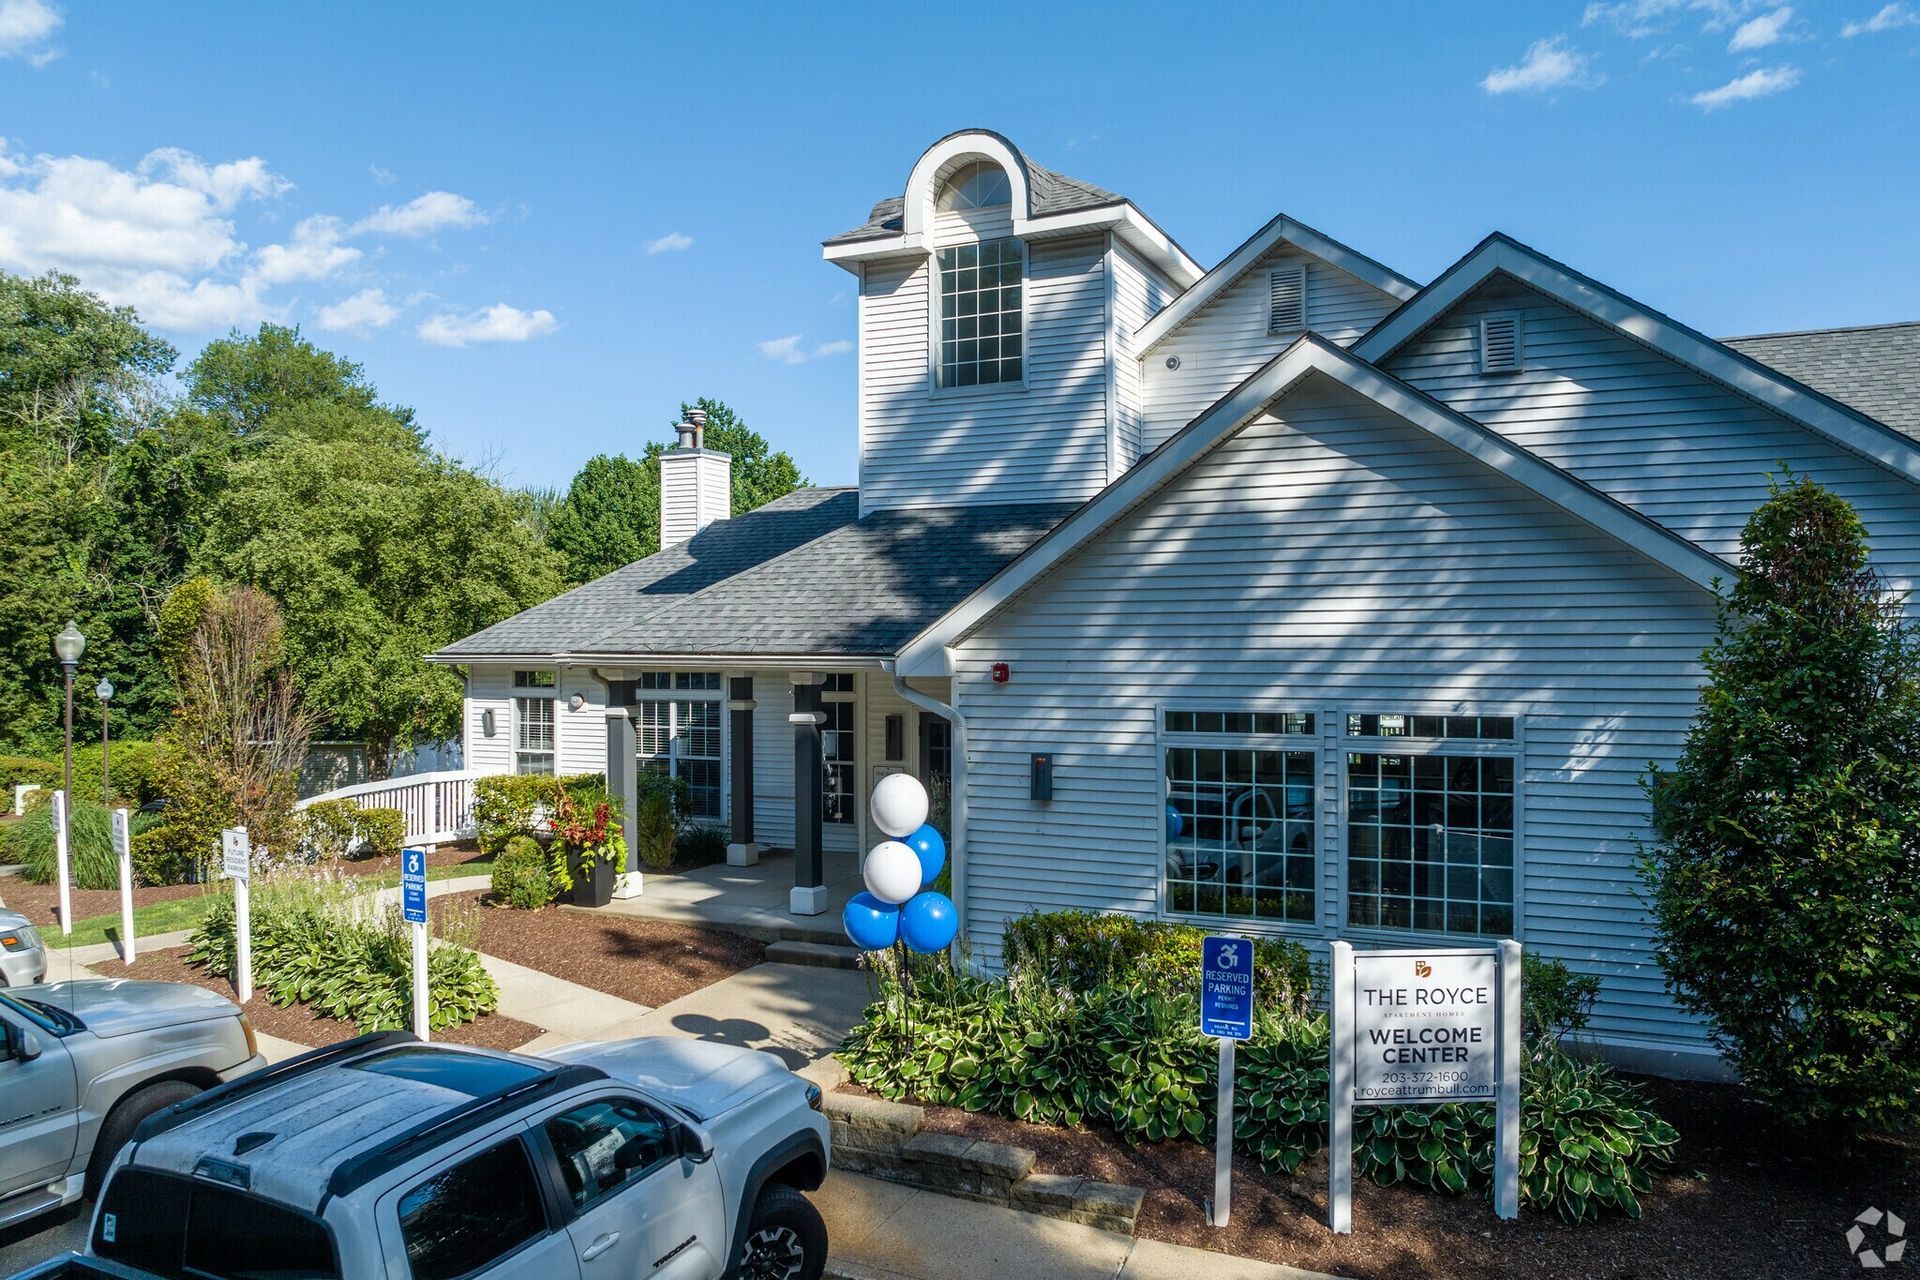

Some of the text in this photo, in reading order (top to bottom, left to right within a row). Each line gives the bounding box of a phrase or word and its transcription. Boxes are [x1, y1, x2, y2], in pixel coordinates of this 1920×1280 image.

[404, 873, 425, 883] RESERVED
[405, 882, 424, 892] PARKING
[1205, 969, 1250, 984] RESERVED
[1208, 982, 1246, 996] PARKING
[1363, 987, 1488, 1006] THE ROYCE
[1369, 1027, 1482, 1045] WELCOME
[1382, 1046, 1469, 1064] CENTER
[1382, 1071, 1469, 1084] 203-372-1600
[1361, 1083, 1489, 1098] royceattrumbull.com
[652, 1234, 697, 1269] TACOMA
